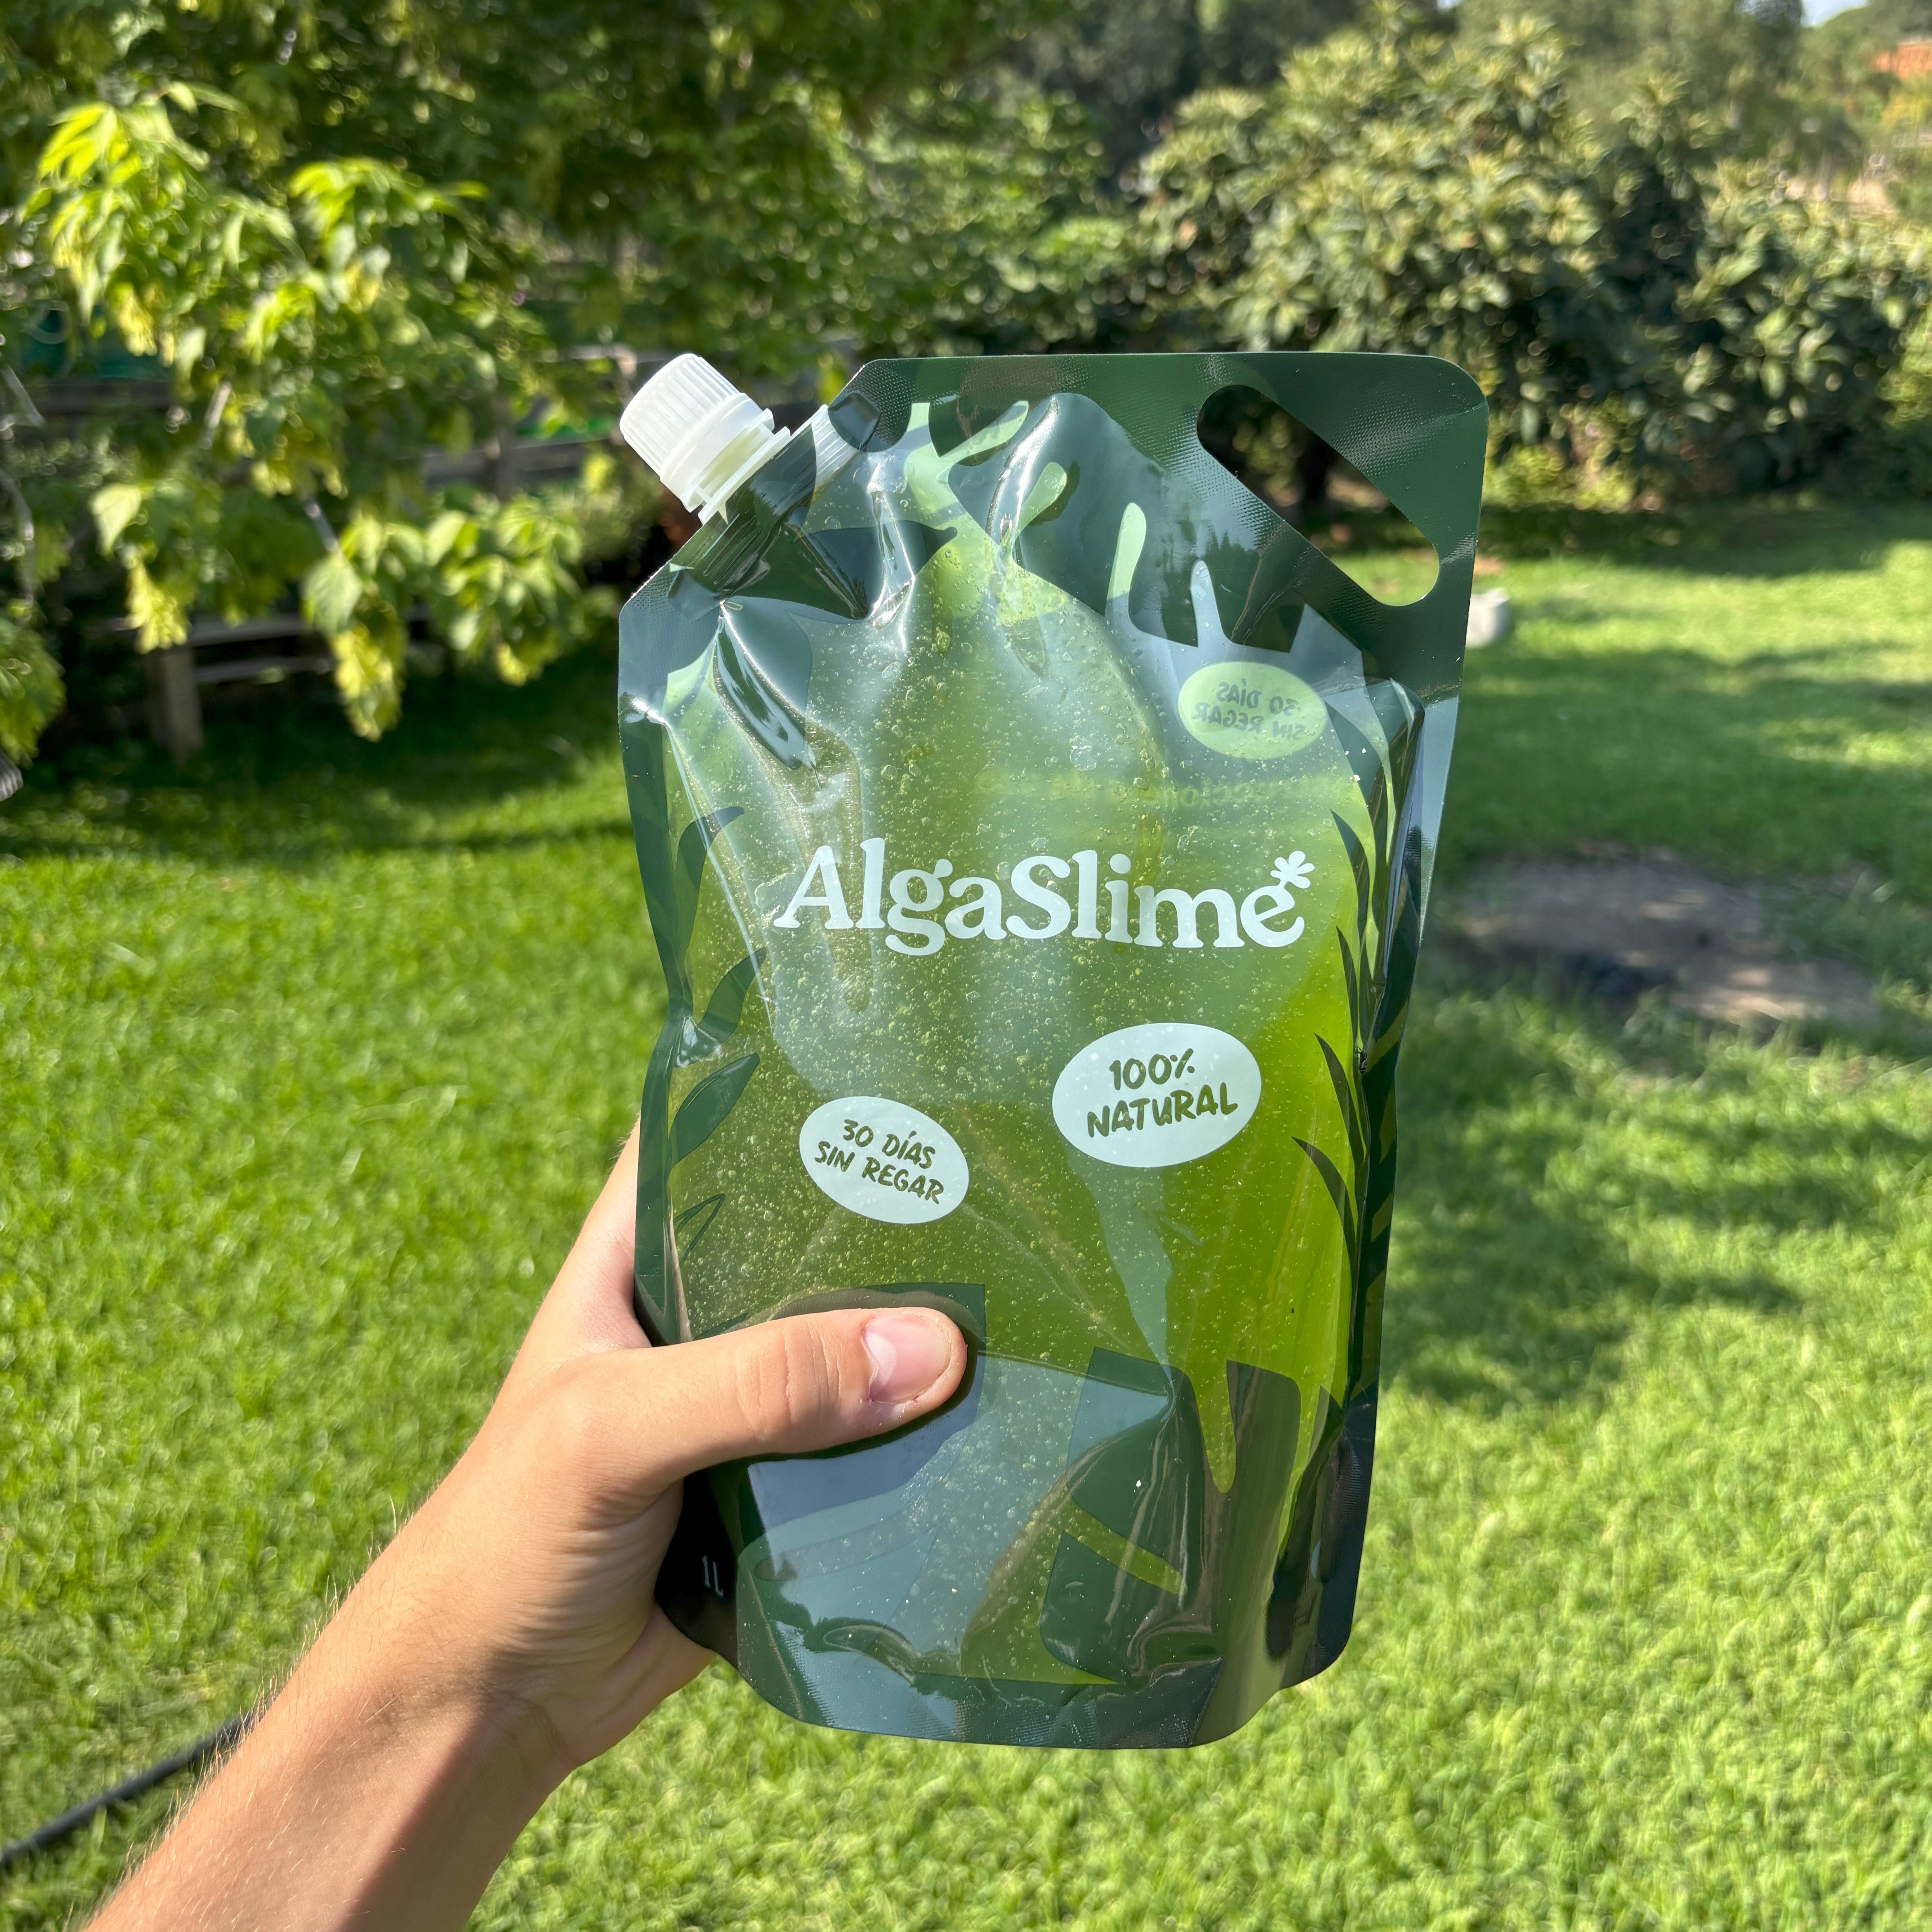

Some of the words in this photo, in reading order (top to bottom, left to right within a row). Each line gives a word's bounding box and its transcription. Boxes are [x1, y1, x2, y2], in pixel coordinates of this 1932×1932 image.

[773, 837, 1305, 956] AlgaSlime
[1109, 1048, 1195, 1090] 100%
[1087, 1082, 1238, 1137] NATURAL
[843, 1119, 874, 1147] 30
[882, 1130, 936, 1169] DÍAS
[814, 1141, 855, 1172] SIN
[862, 1157, 944, 1204] REGAR
